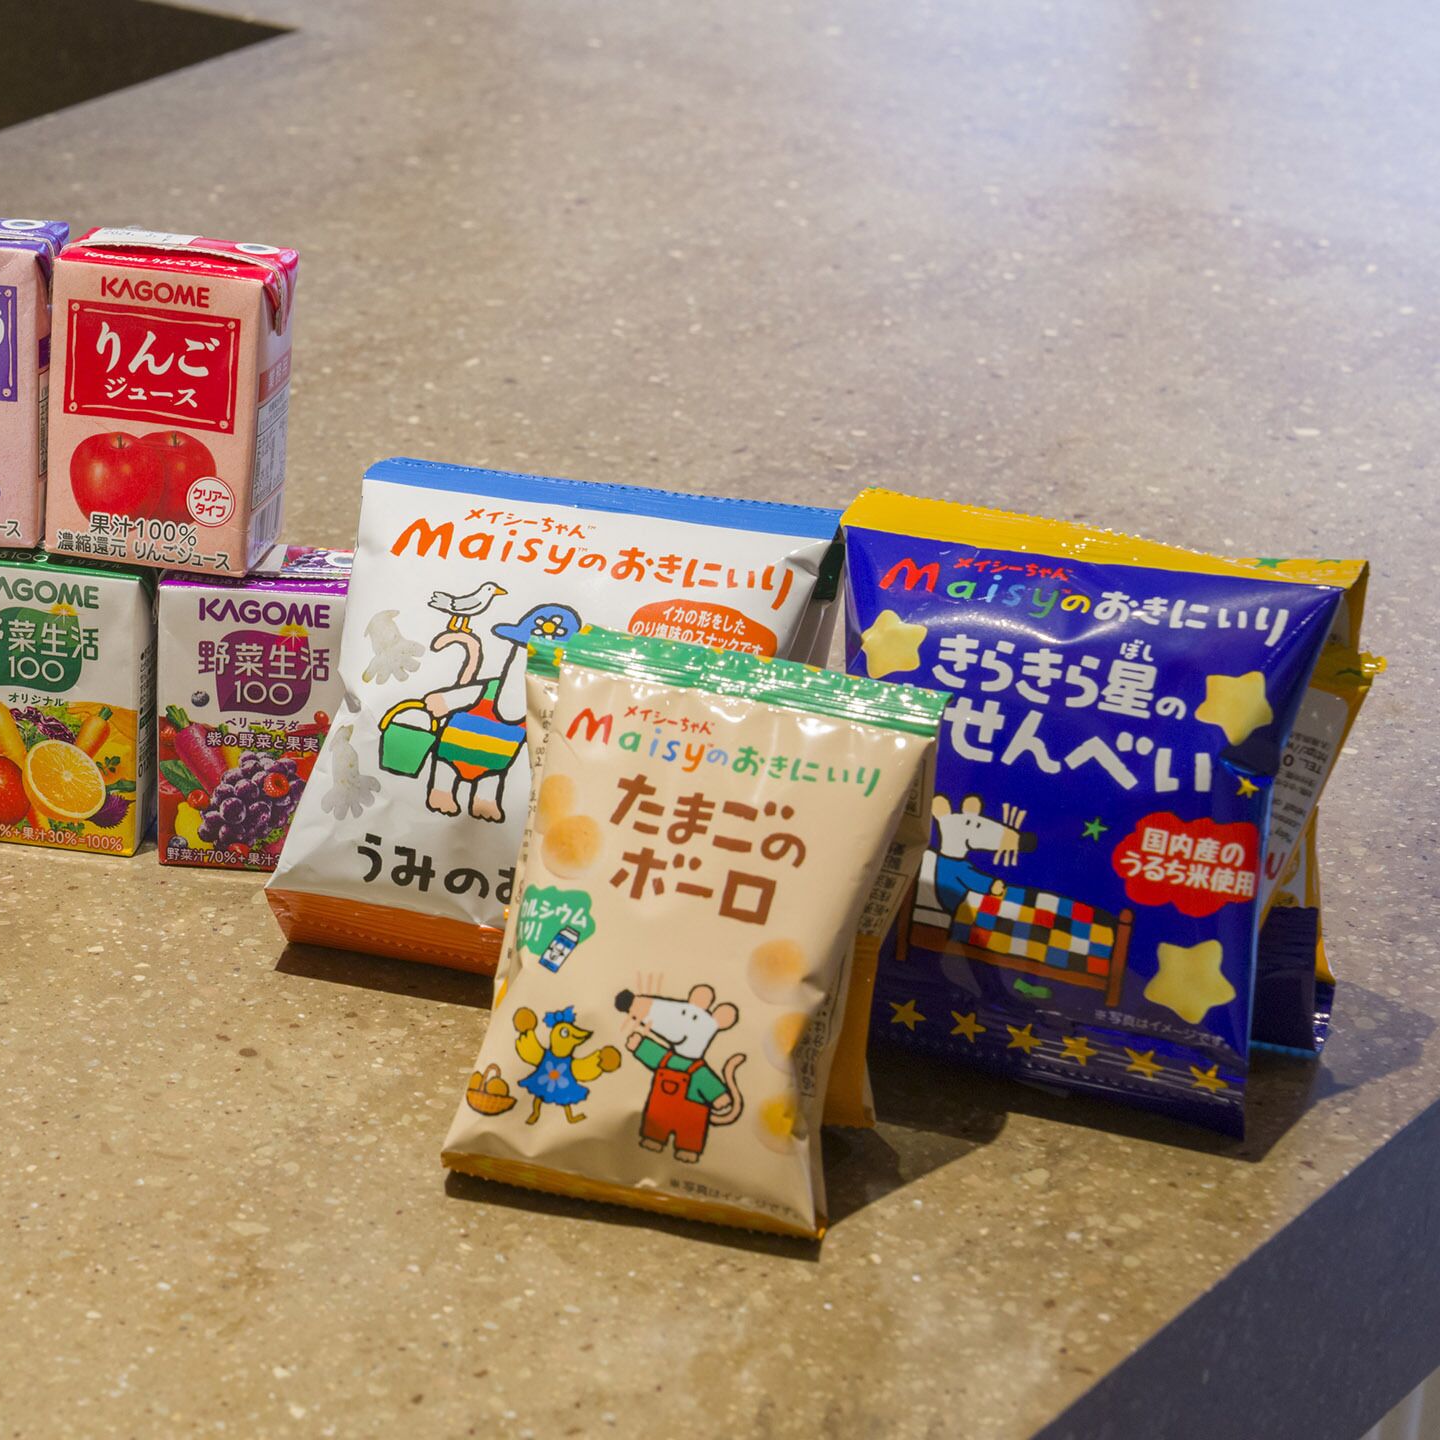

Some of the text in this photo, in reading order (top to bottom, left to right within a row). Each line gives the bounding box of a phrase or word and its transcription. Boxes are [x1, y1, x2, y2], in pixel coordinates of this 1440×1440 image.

[84, 251, 147, 263] KAGOME
[101, 276, 210, 308] KAGOME
[95, 320, 221, 378] りんご
[103, 376, 199, 408] ジュース
[192, 487, 230, 503] クリアー
[194, 502, 227, 518] タイプ
[90, 513, 198, 547] 果汁100%
[57, 531, 231, 571] 濃縮還元 りんごジュース
[198, 597, 331, 629] KAGOME
[662, 605, 747, 637] イカの形をした
[197, 640, 330, 682] 野菜生活
[1119, 639, 1155, 662] ぼし
[8, 656, 65, 683] 100
[931, 633, 1187, 721] きらきら星の
[8, 692, 65, 708] オリジナル
[234, 680, 293, 706] 100
[225, 717, 300, 731] ベリーサラダ
[206, 731, 320, 752] 紫の野菜と果実
[943, 695, 1213, 794] せんべい
[608, 773, 807, 869] たまごの
[1140, 825, 1246, 867] 国内産の
[608, 846, 778, 926] ボーロ
[1119, 850, 1257, 898] うるち米使用
